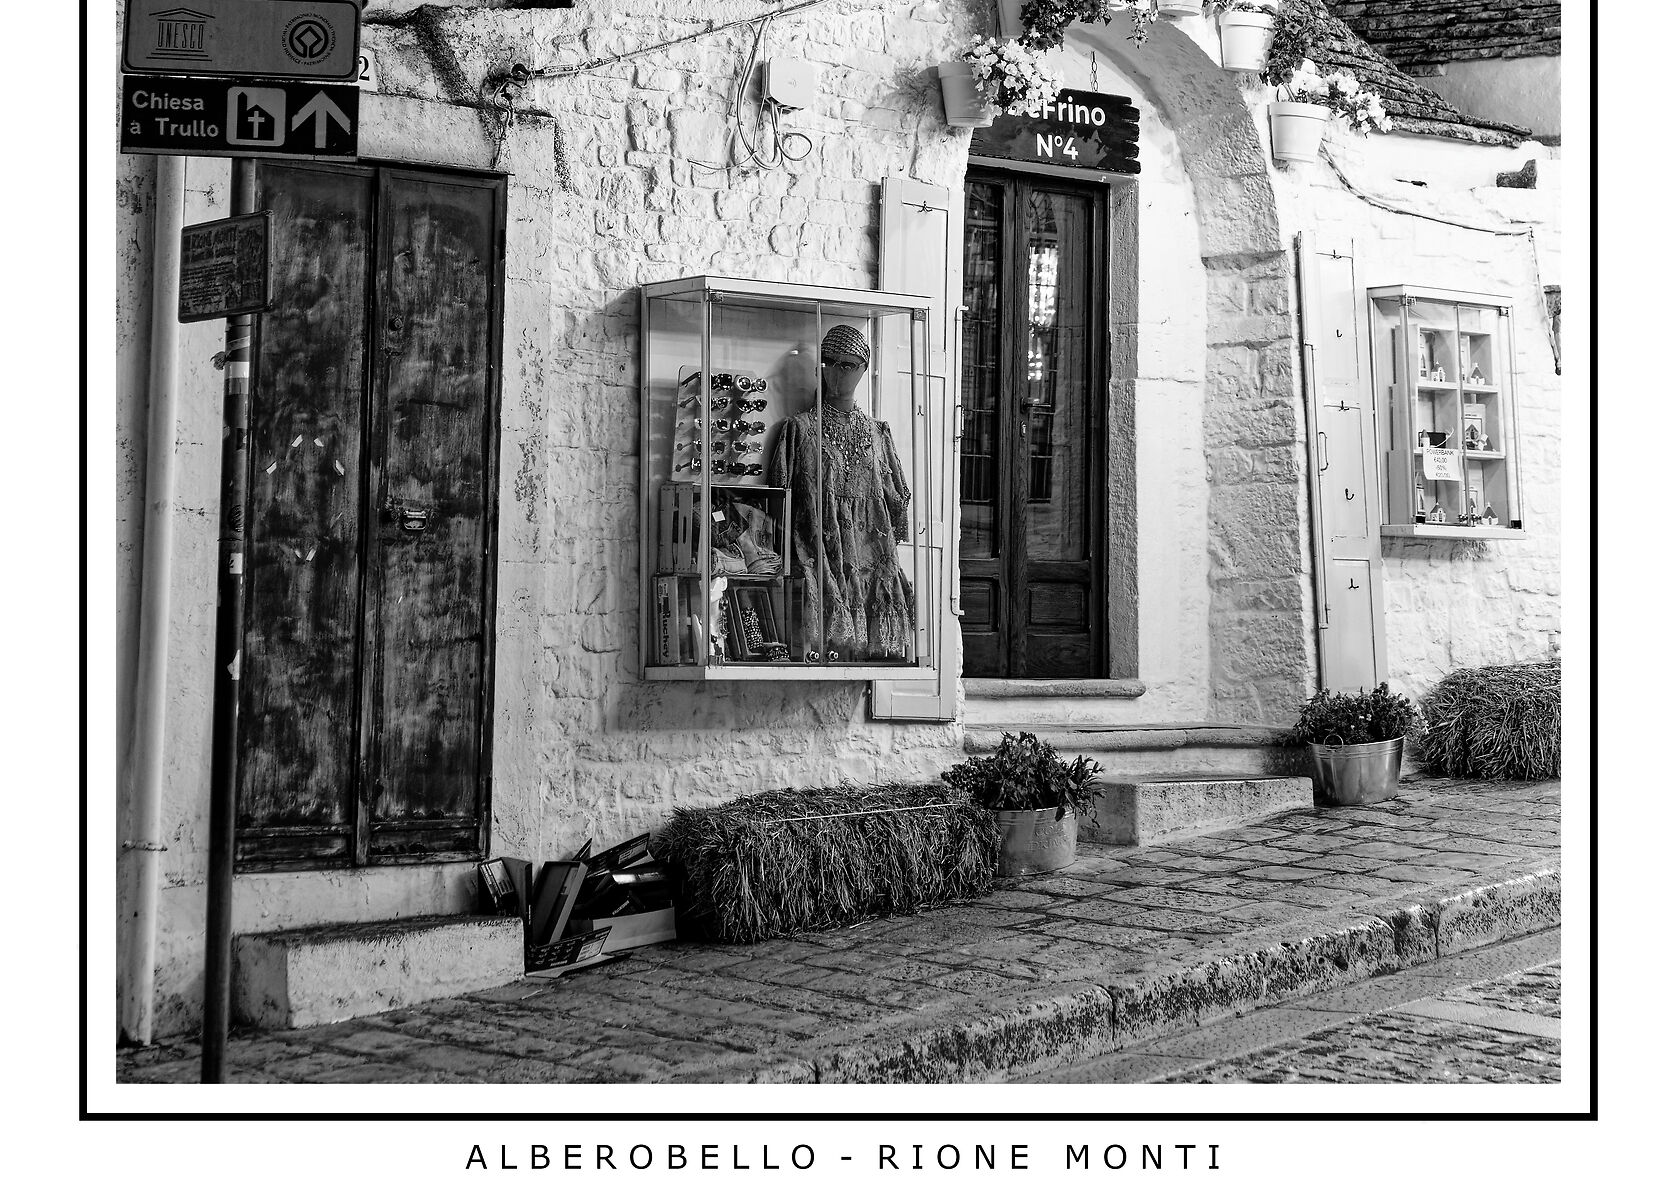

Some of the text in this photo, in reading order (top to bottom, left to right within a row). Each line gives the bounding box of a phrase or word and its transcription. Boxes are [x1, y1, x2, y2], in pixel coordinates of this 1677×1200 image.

[157, 21, 205, 50] UNESCO
[132, 90, 205, 111] Chiesa
[155, 117, 219, 137] Trullo
